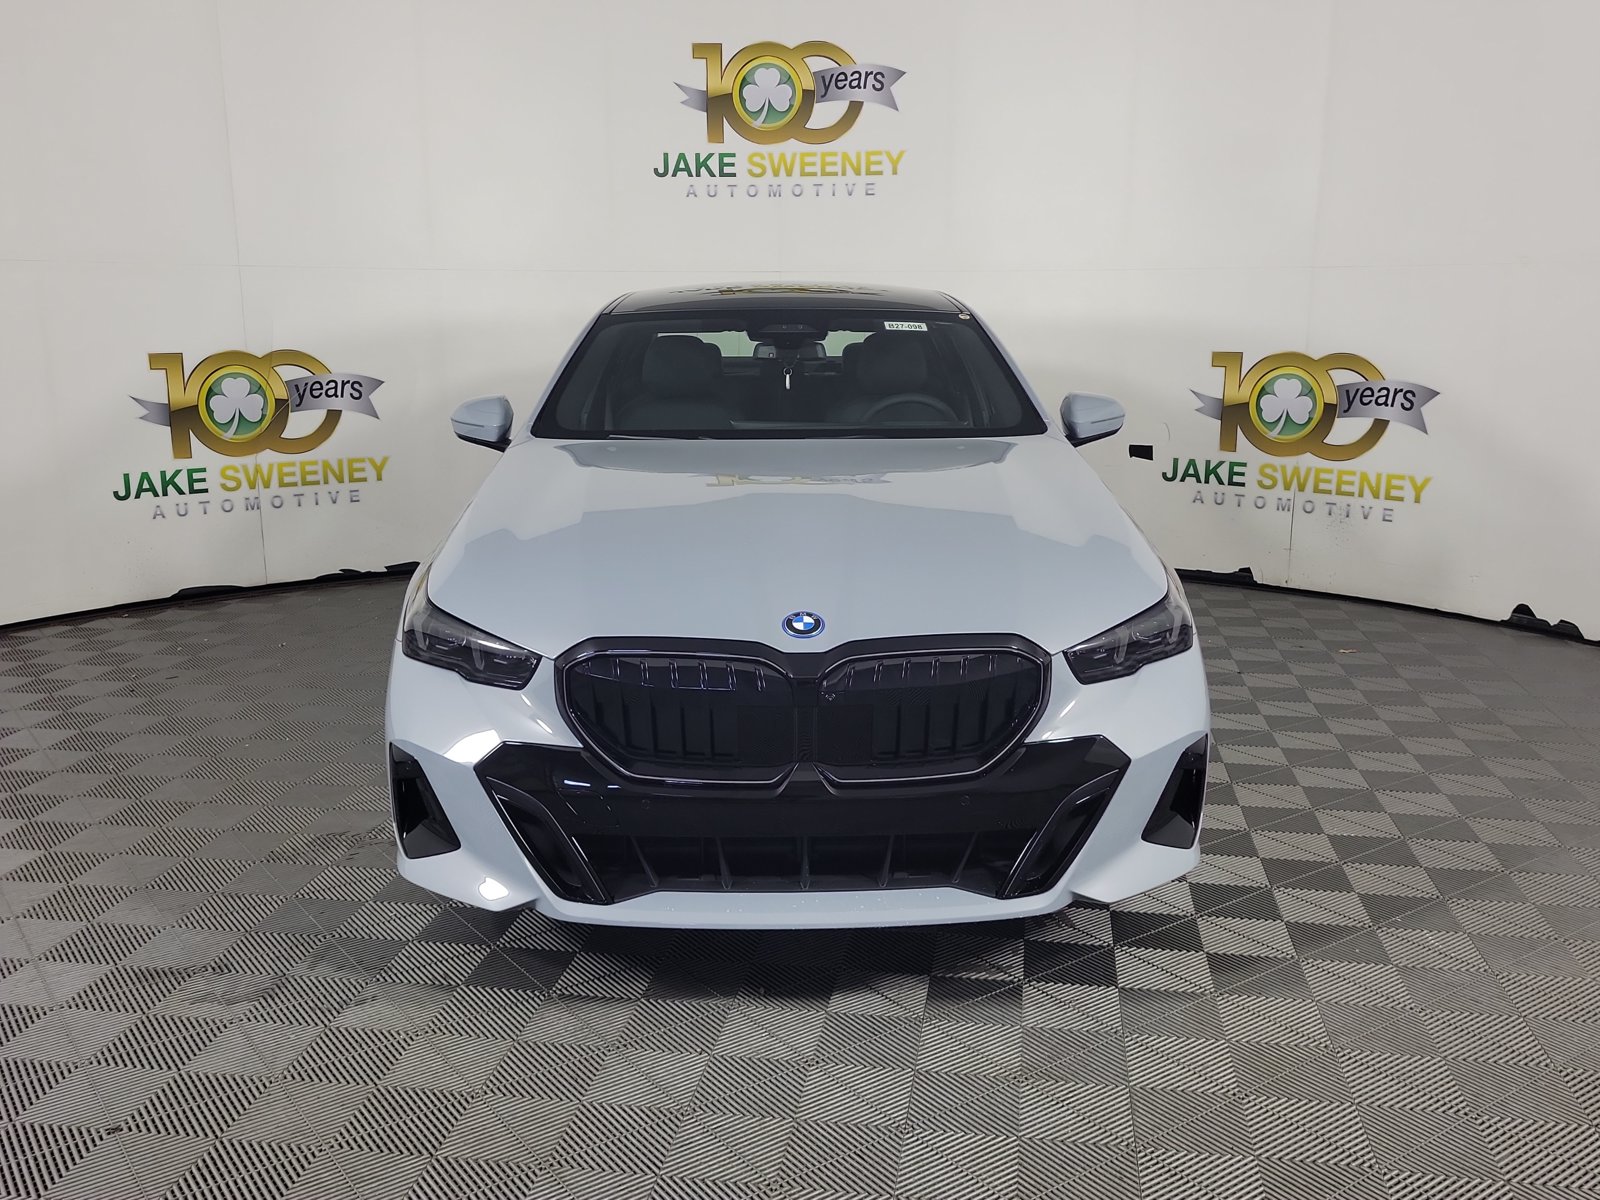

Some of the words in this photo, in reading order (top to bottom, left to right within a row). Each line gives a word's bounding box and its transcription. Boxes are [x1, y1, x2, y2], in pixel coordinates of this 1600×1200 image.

[691, 40, 864, 144] 100
[820, 69, 885, 98] years
[653, 152, 737, 178] JAKE
[746, 150, 906, 177] SWEENEY
[686, 183, 876, 198] AUTOMOTIVE
[148, 349, 342, 459] 100
[294, 379, 363, 407] years
[1211, 351, 1391, 461] 100
[1343, 386, 1417, 413] years
[112, 467, 209, 501] JAKE
[219, 456, 390, 492] SWEENEY
[1161, 457, 1248, 487] JAKE
[1256, 463, 1433, 504] SWEENEY
[152, 489, 361, 520] AUTOMOTIVE
[1192, 490, 1394, 523] AUTOMOTIVE
